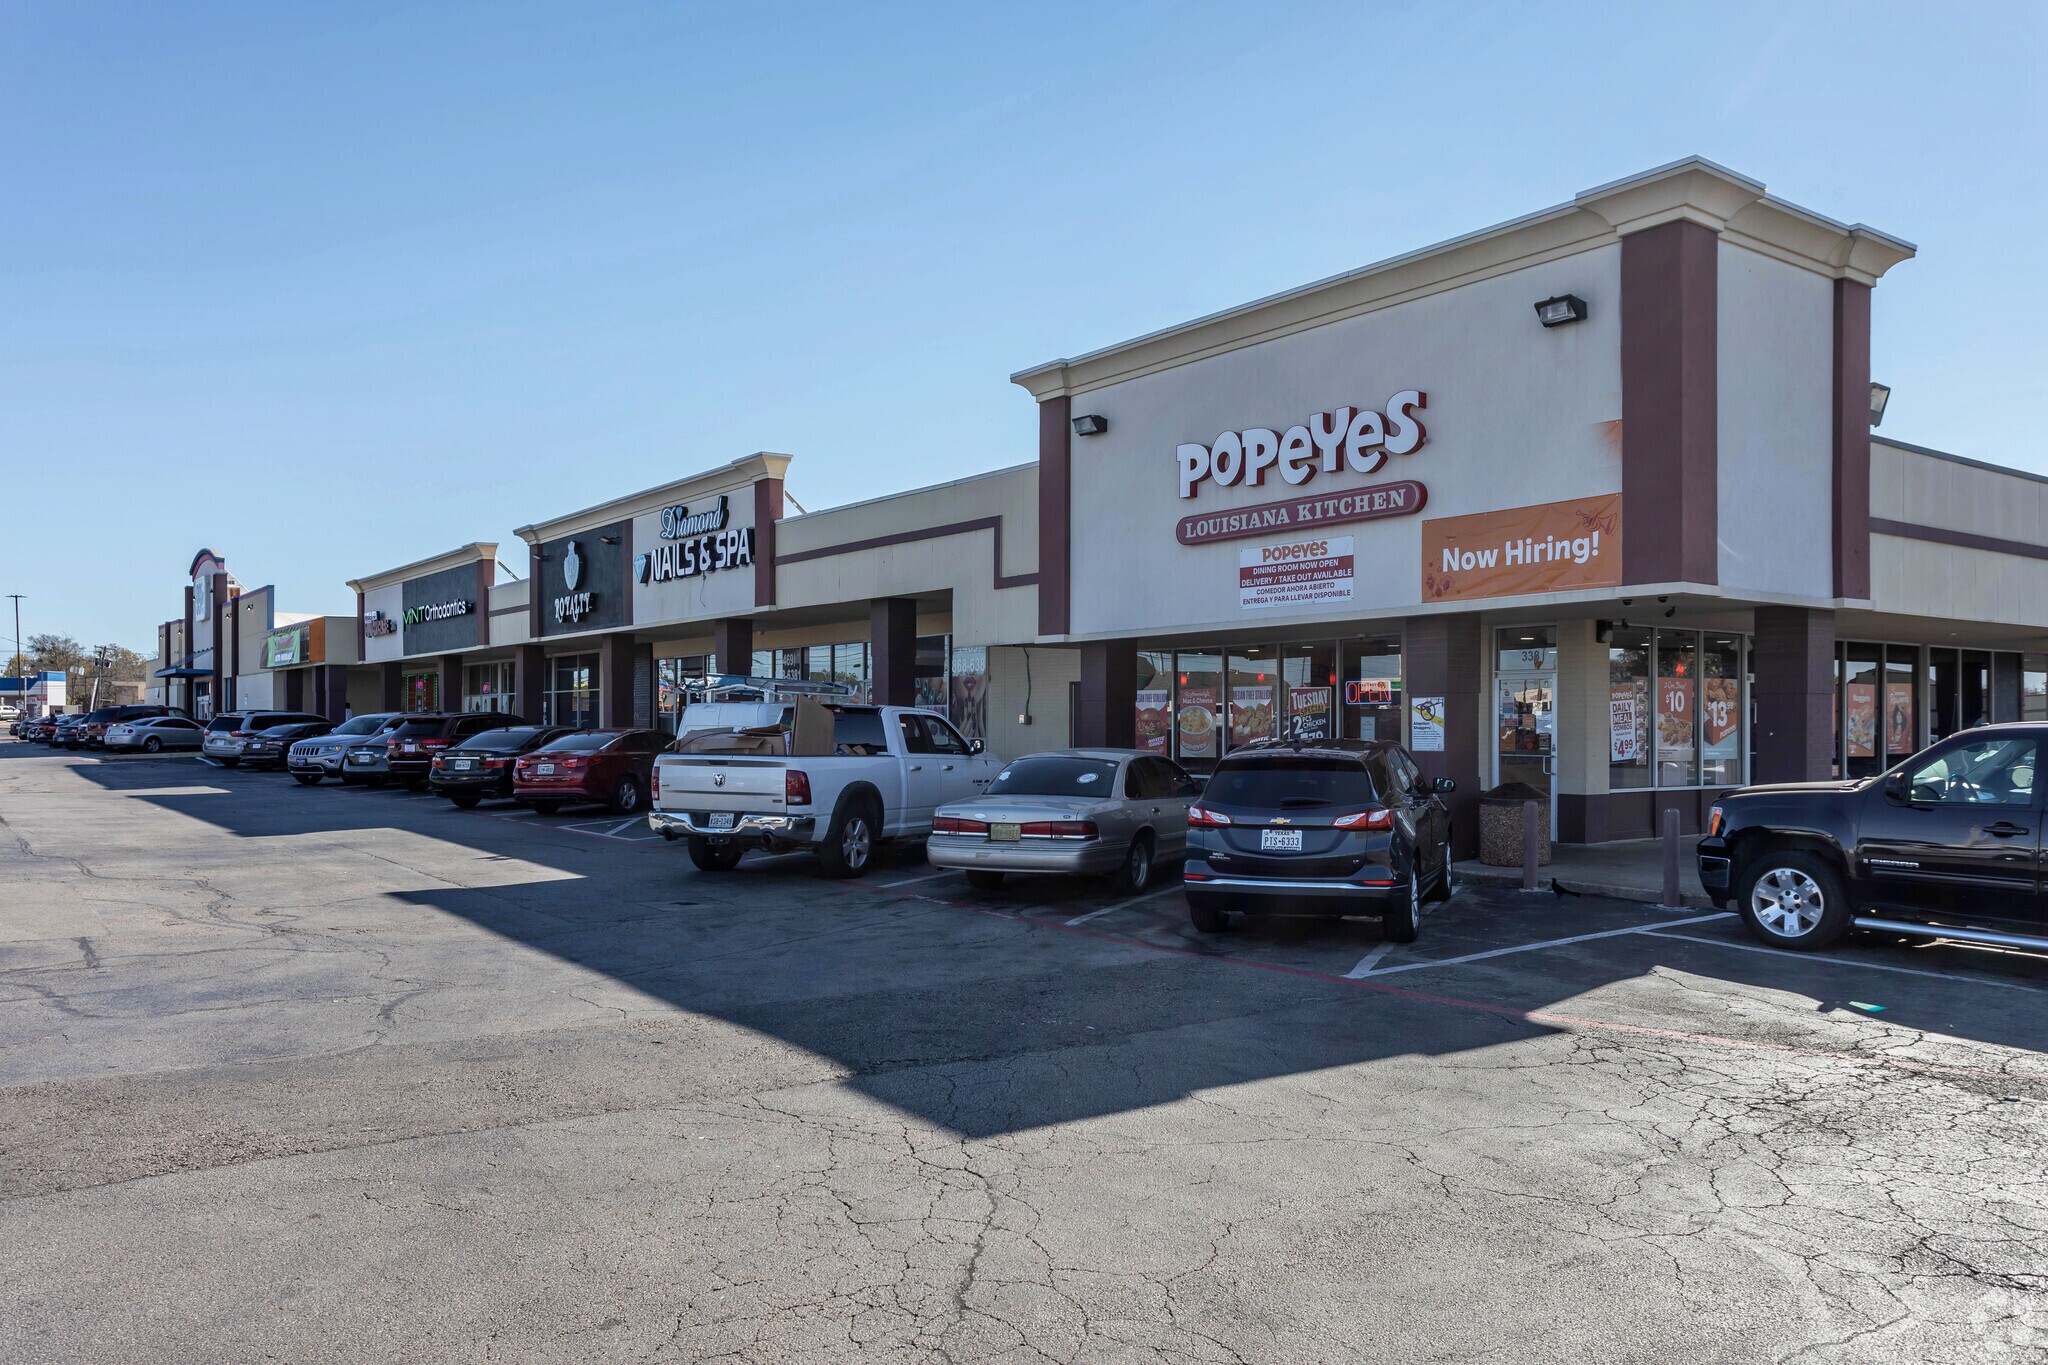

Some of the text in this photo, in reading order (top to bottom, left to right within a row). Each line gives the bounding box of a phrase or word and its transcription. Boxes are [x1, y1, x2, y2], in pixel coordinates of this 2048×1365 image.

[660, 495, 724, 539] Diamond
[1185, 489, 1406, 539] LOUISIANA KITCHEN
[651, 528, 750, 581] NAILS & SPA
[1442, 530, 1600, 573] Now Hiring!
[1253, 558, 1339, 575] DINING ROOM NOW OPEN
[1241, 577, 1273, 587] DELIVERY
[1279, 575, 1296, 583] TAKE
[1296, 572, 1312, 581] OUT
[1313, 568, 1352, 579] AVAILABLE
[1243, 596, 1269, 605] ENTREGA
[1274, 595, 1290, 603] PARA
[1290, 592, 1313, 601] LLEVAR
[1314, 589, 1351, 599] DISPONIBLE
[1256, 582, 1335, 595] COMEDOR AHORA ABIERTO
[424, 598, 467, 622] Orthodontics
[555, 592, 590, 623] ROYALTY
[1290, 689, 1328, 710] TUESDAY
[1346, 682, 1391, 703] OPEN
[1665, 690, 1685, 713] $10
[1300, 703, 1326, 717] SPECIAL
[1613, 702, 1631, 713] DAILY
[1292, 715, 1304, 735] 2
[1303, 717, 1327, 729] CHICKEN
[1613, 712, 1632, 724] MEAL
[1613, 723, 1633, 731] COMBOS
